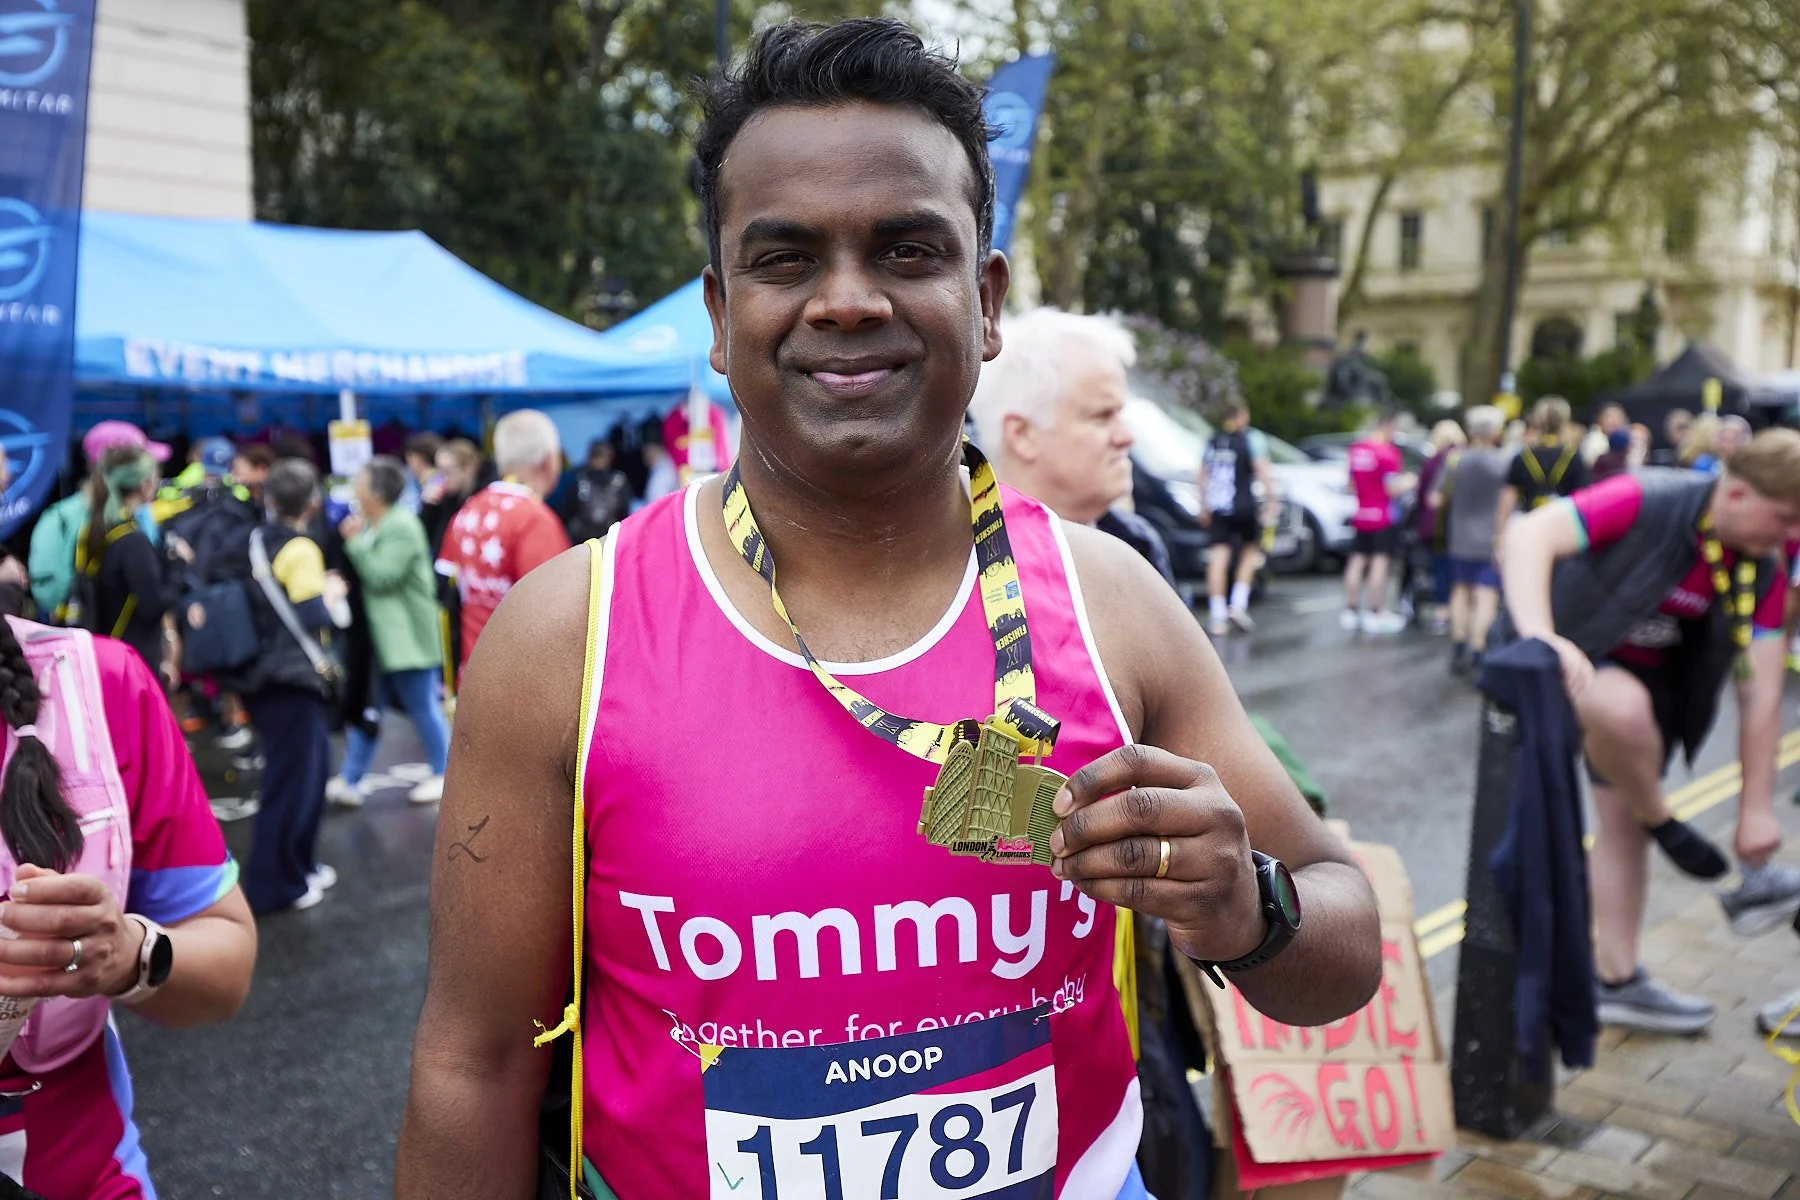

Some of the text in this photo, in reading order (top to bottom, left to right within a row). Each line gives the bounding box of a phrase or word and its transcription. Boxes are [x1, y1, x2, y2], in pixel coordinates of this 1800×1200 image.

[975, 517, 1003, 545] FINISHER
[995, 624, 1027, 650] FINISHER
[1016, 700, 1059, 727] FINISHER
[952, 841, 988, 852] LONDON
[996, 851, 1031, 859] LANDMARKS
[619, 880, 1097, 980] Tommy's
[845, 1013, 903, 1042] for
[825, 1046, 943, 1085] ANOOP
[1316, 1053, 1426, 1150] GO!
[737, 1082, 1037, 1200] 11787
